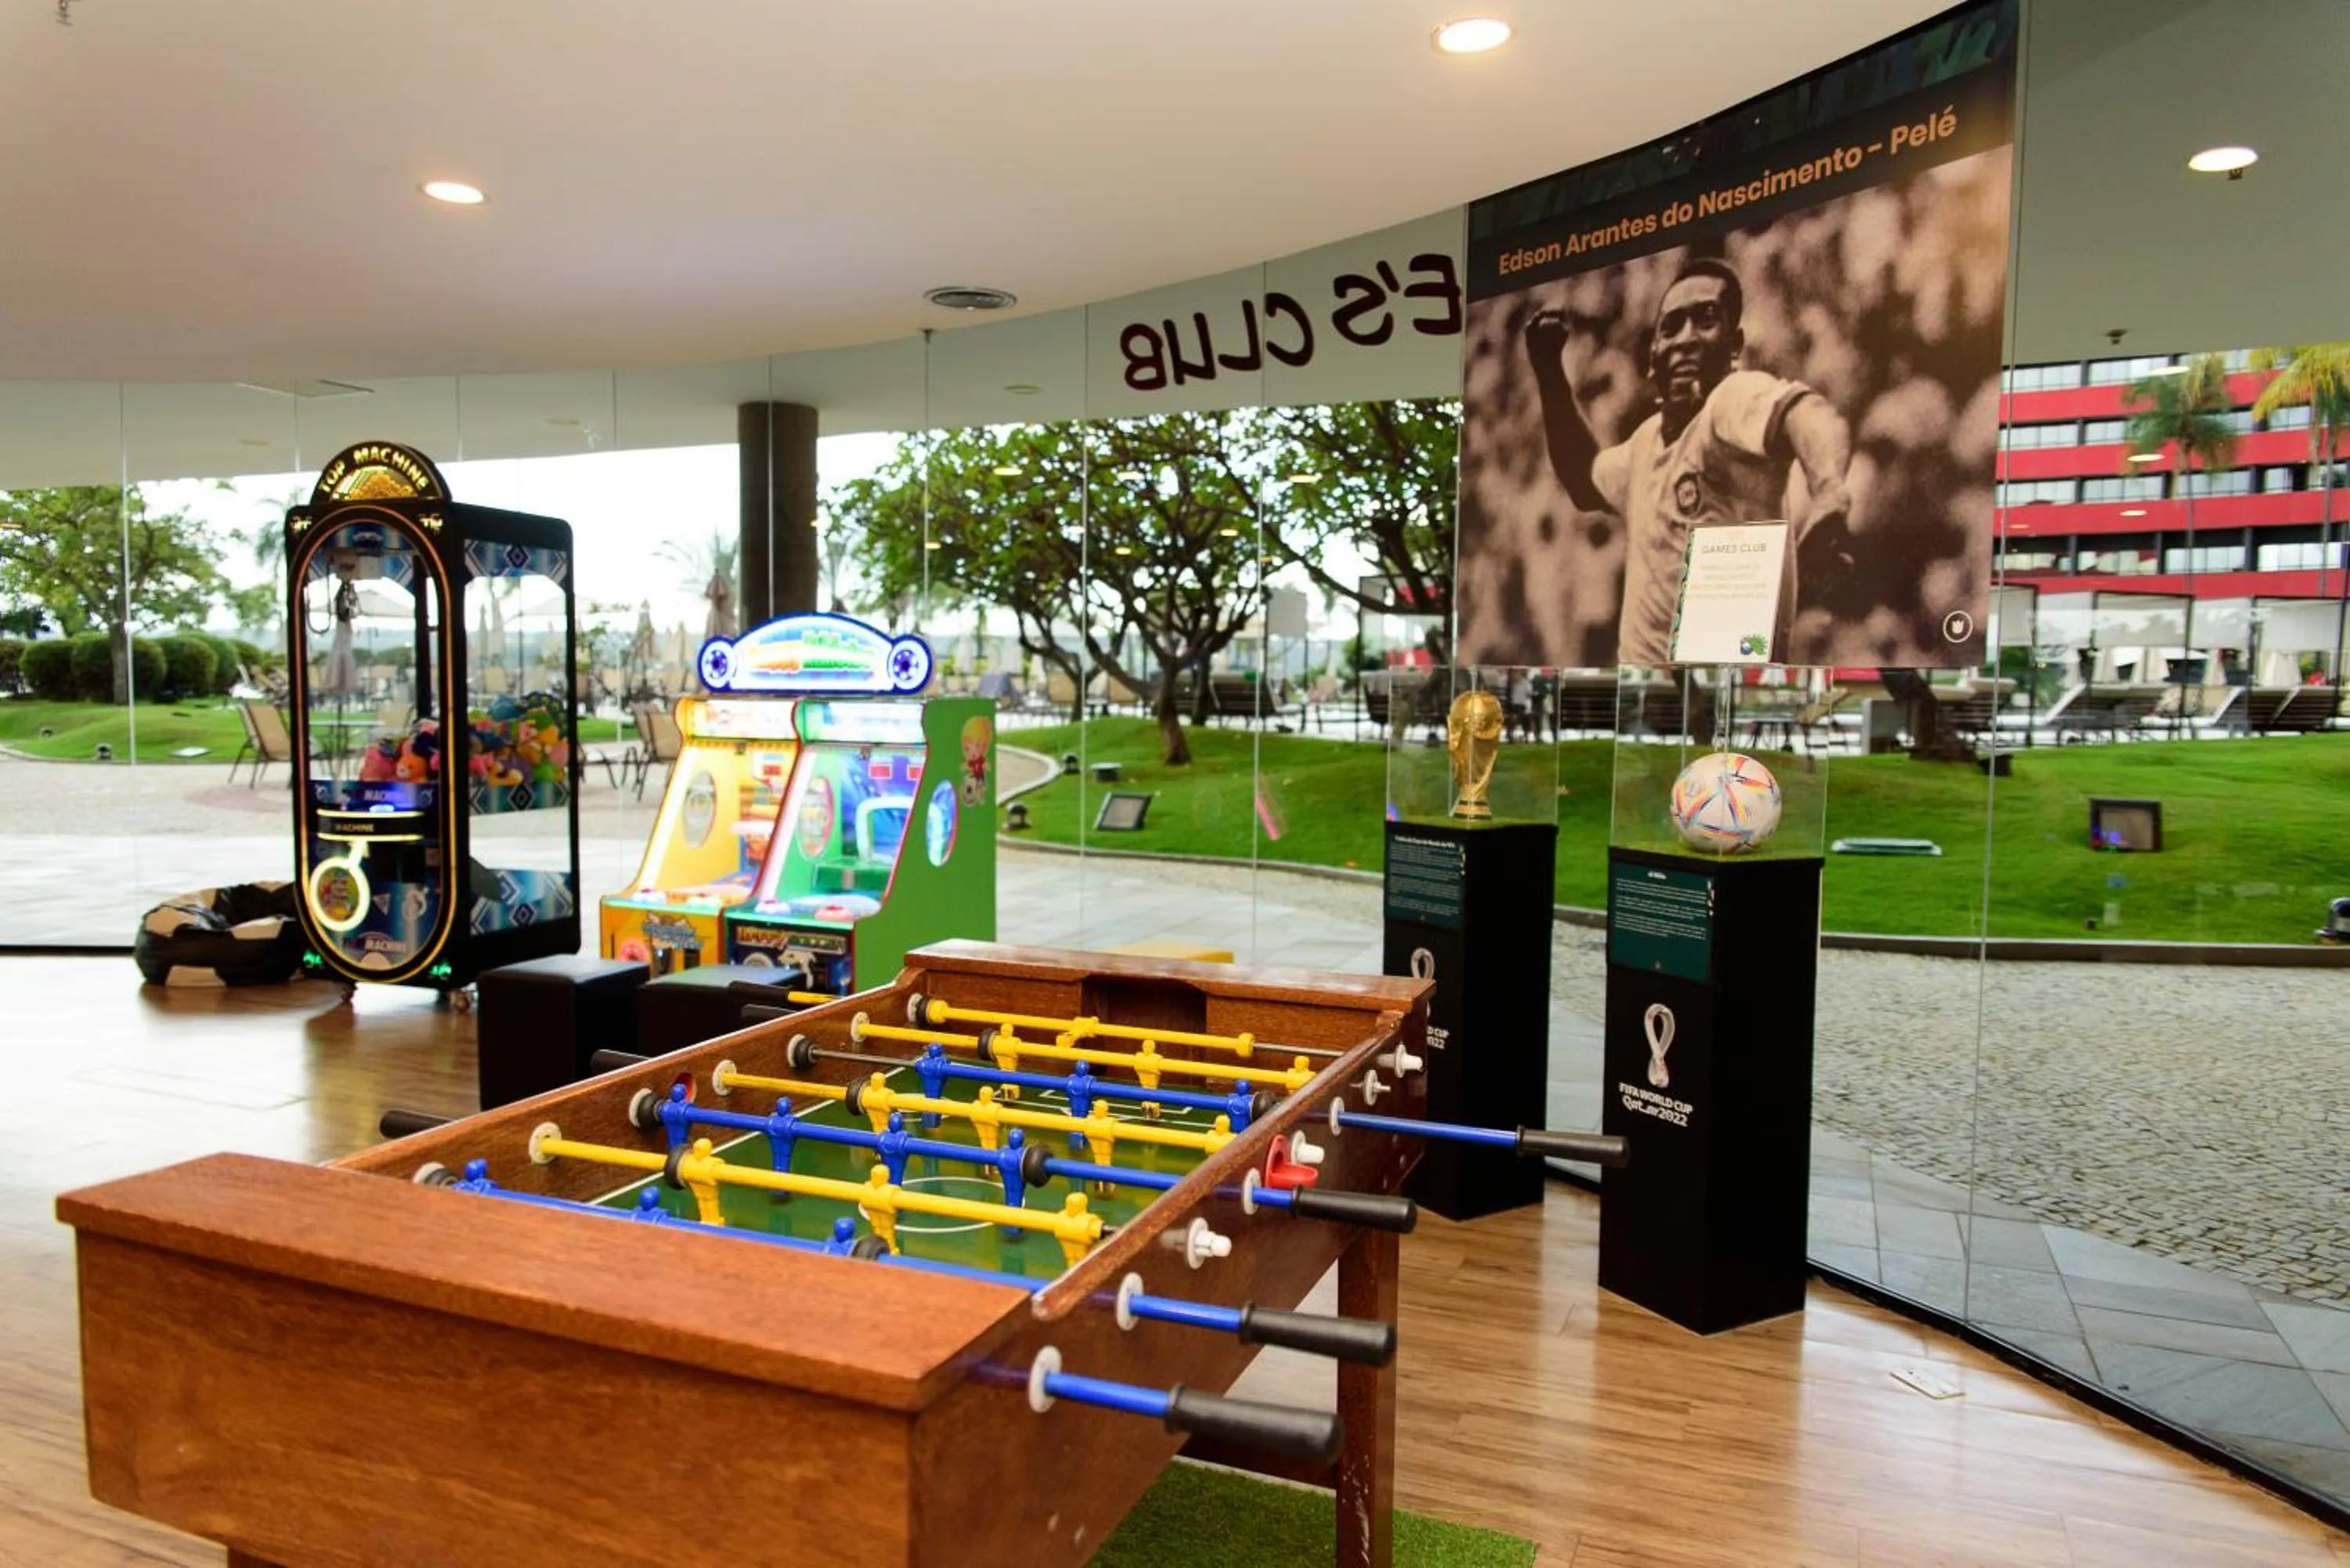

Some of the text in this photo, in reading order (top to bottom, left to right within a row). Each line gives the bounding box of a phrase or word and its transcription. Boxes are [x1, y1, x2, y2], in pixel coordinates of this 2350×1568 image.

[1499, 104, 1958, 276] Edson Arantes do Nascimento - Pelé
[318, 446, 429, 493] TOP MACHINE
[1702, 543, 1767, 555] GAMES CLUB
[1618, 1082, 1693, 1115] FIFA WORLD CUP
